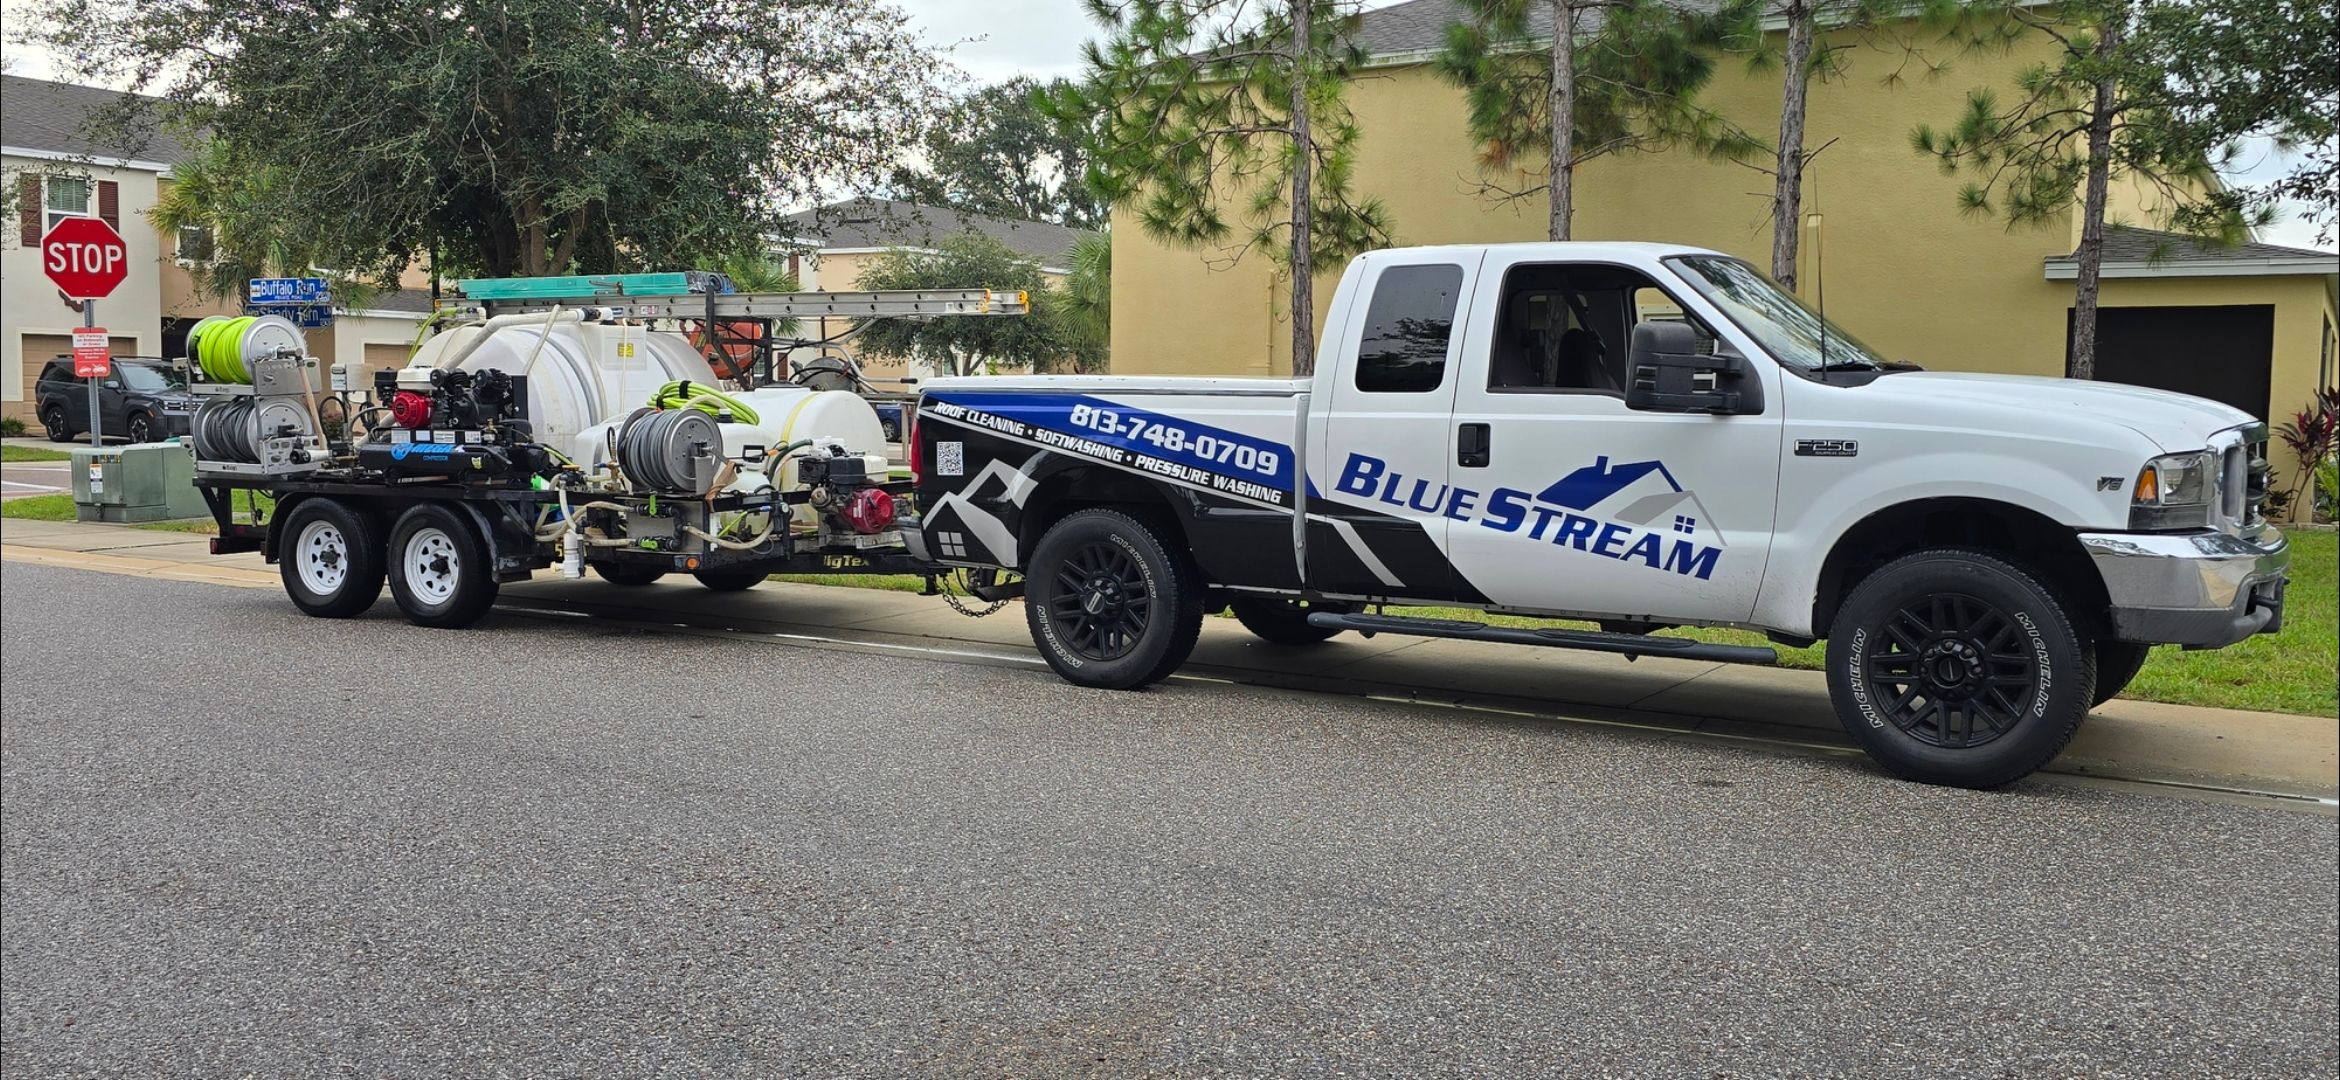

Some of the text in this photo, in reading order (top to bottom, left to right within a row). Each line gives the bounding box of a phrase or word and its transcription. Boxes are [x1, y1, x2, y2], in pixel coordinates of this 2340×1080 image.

[48, 241, 123, 274] STOP
[260, 280, 293, 296] Buffalo
[296, 279, 316, 295] Run
[933, 401, 1283, 504] ROOF CLEANING SOFTWASHING PRESSURE WASHING
[1070, 403, 1280, 477] 813-748-0709
[1110, 533, 1157, 599] MICHELIN
[1036, 604, 1084, 668] MICHELIN
[2014, 611, 2052, 719] MICHELIN
[1849, 627, 1884, 730] MICHELIN
